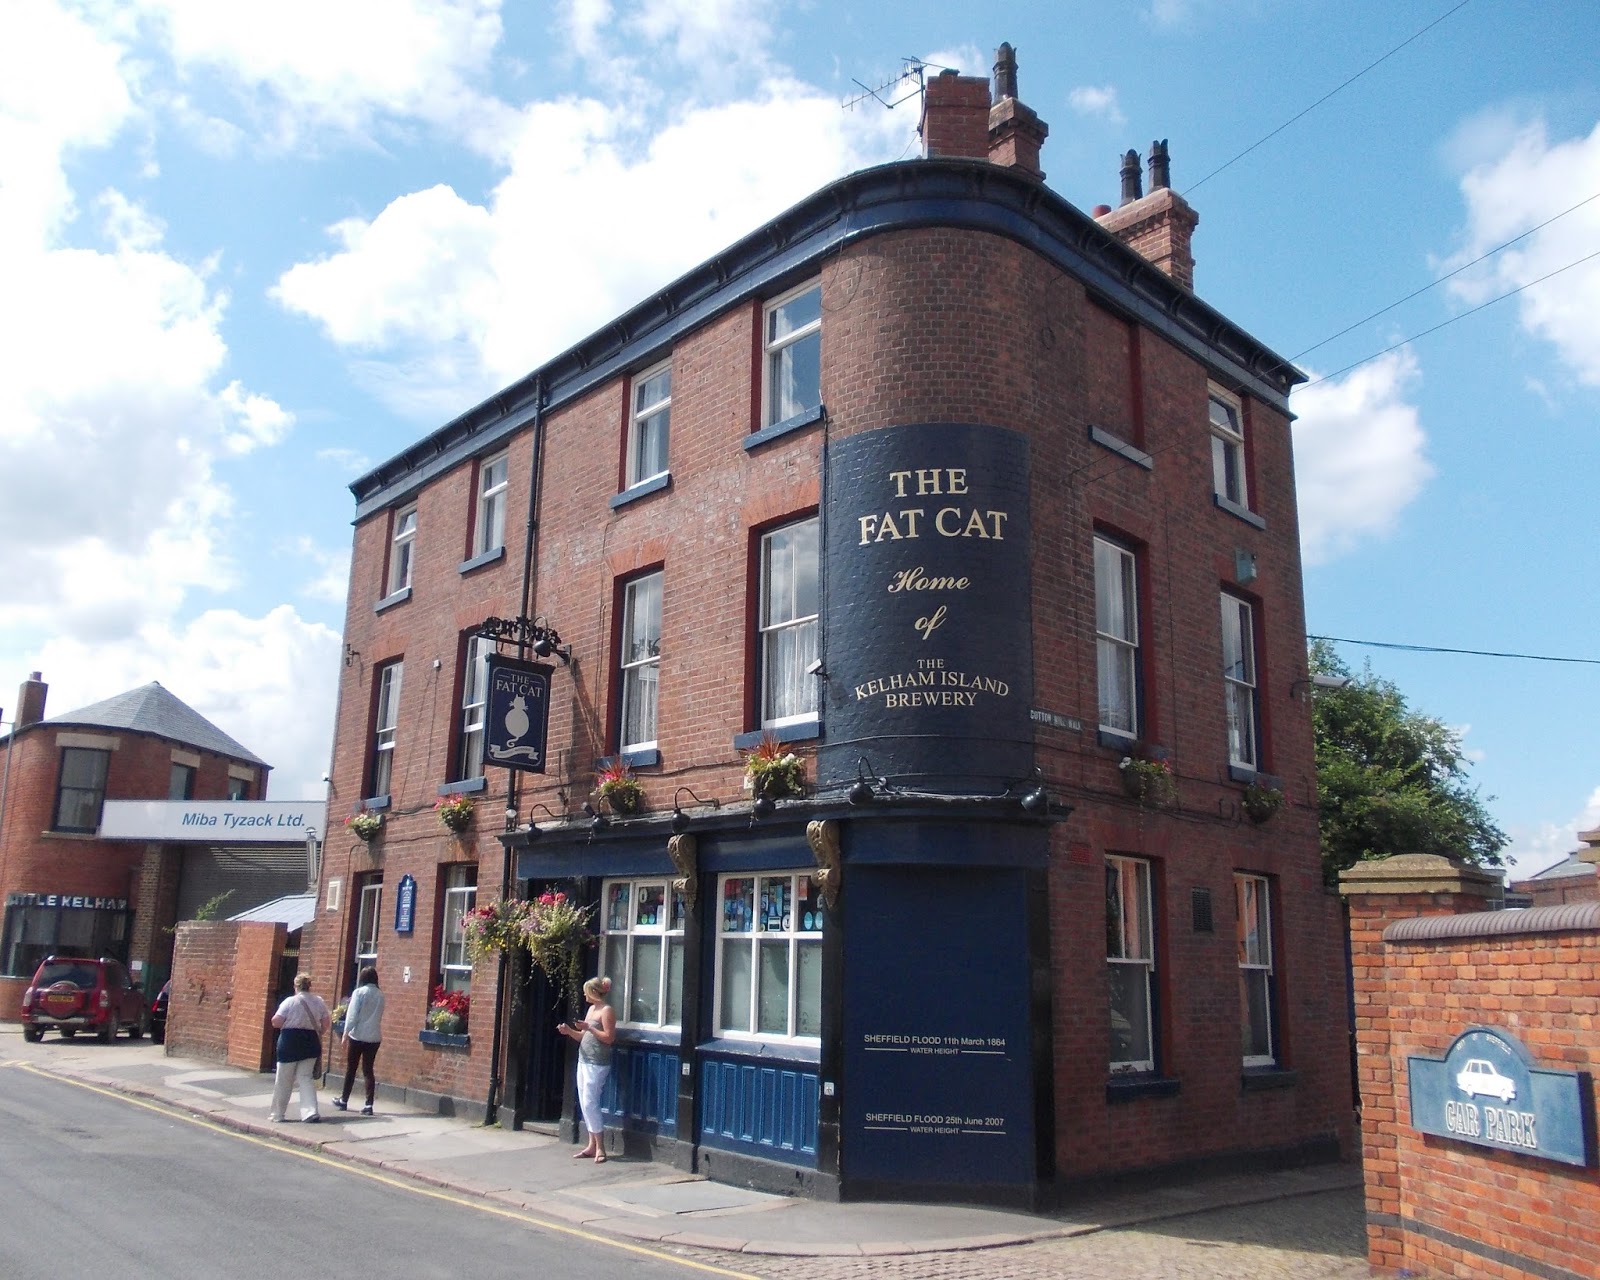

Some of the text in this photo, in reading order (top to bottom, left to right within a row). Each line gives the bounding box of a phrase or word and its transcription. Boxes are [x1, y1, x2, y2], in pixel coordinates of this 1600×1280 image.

[889, 468, 969, 498] THE
[858, 507, 1008, 545] FAT CAT
[887, 566, 971, 593] Home
[914, 605, 947, 640] of
[916, 658, 945, 669] THE
[510, 673, 530, 685] THE
[854, 670, 1009, 701] KELHAM ISLAND
[496, 679, 543, 698] FAT CAT
[886, 691, 978, 708] BREWERY
[181, 812, 305, 829] Miba Tyzack Ltd.
[864, 1034, 1006, 1047] SHEFFIELD FLOOD 11th March 1864
[910, 1047, 960, 1055] WATER HEIGHT
[865, 1112, 1005, 1126] SHEFFIELD FLOOD 25th June 2007
[1445, 1100, 1538, 1149] CAR PARK
[910, 1126, 960, 1135] WATER HEIGHT
